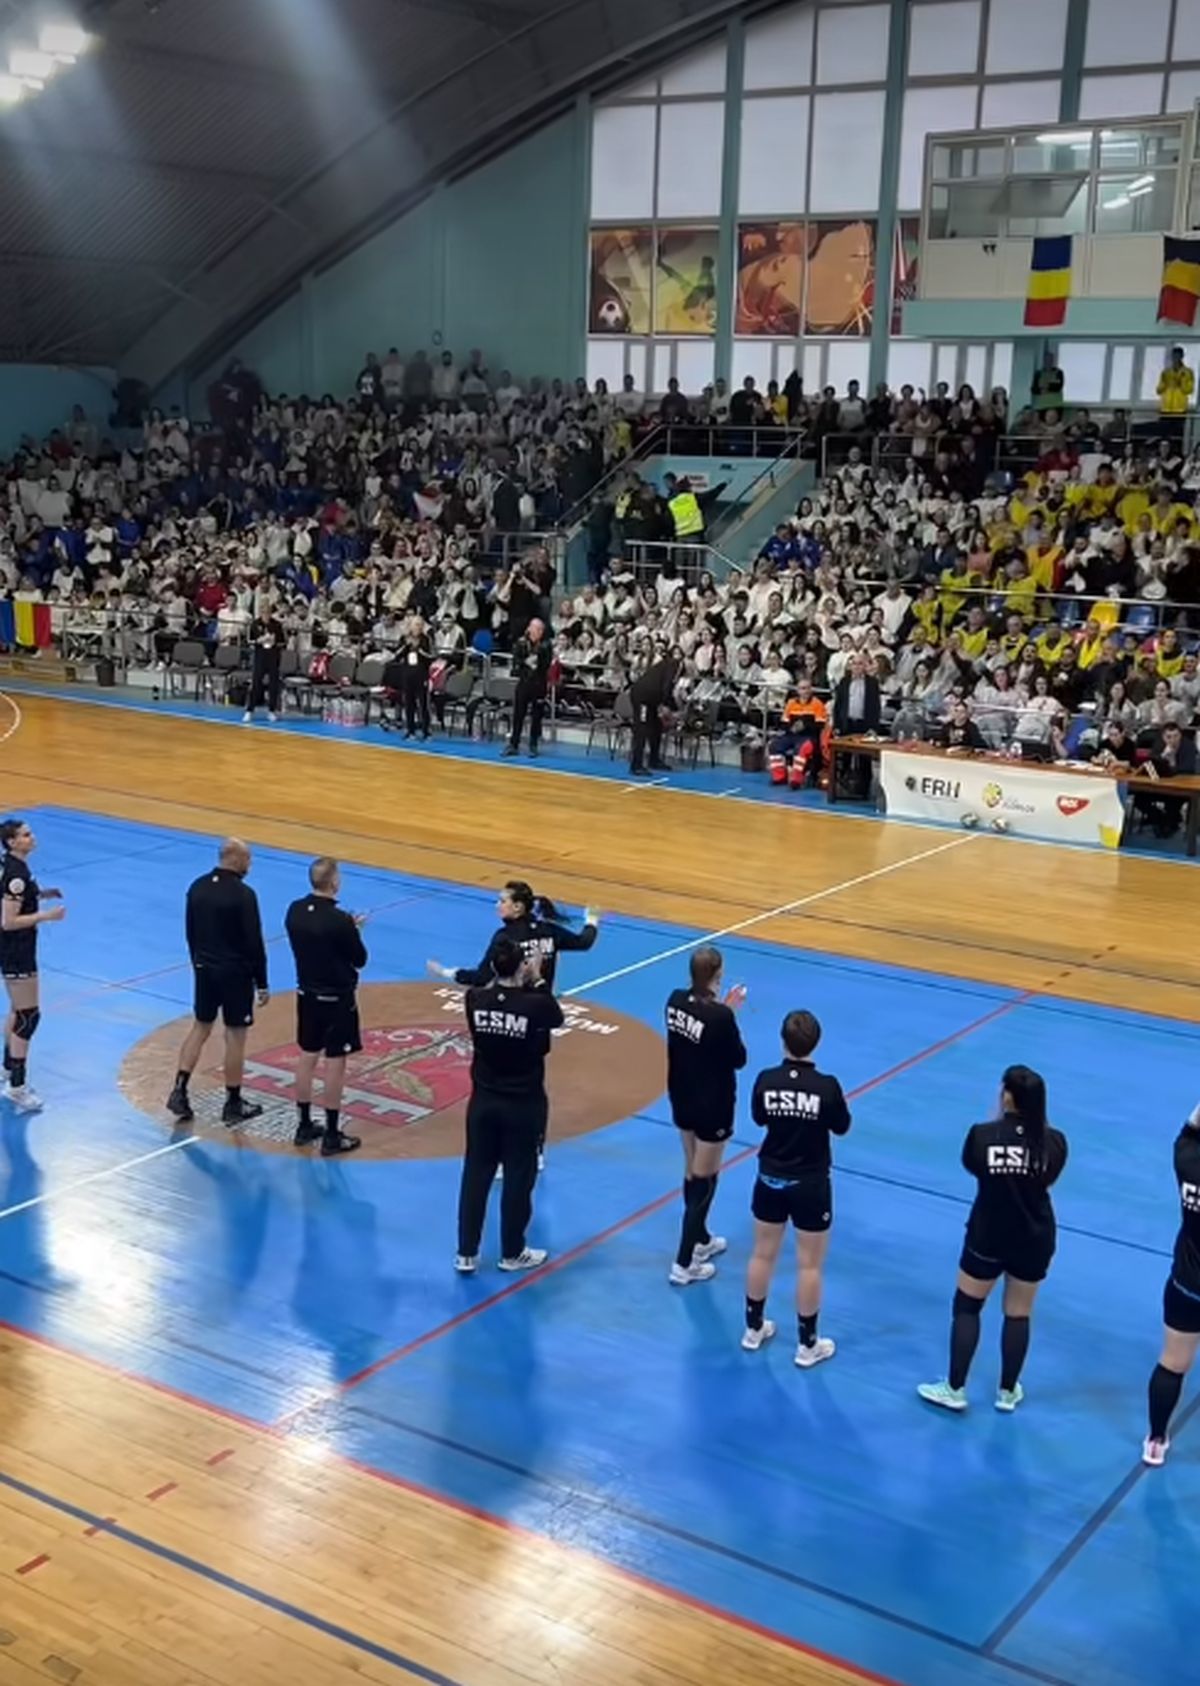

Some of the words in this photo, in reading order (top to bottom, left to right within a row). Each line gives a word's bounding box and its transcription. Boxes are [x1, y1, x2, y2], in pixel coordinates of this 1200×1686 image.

[473, 1010, 528, 1033] CSM
[667, 1006, 704, 1039] CSM
[764, 1090, 820, 1114] CSM
[987, 1143, 1030, 1168] CS
[1182, 1182, 1200, 1206] C
